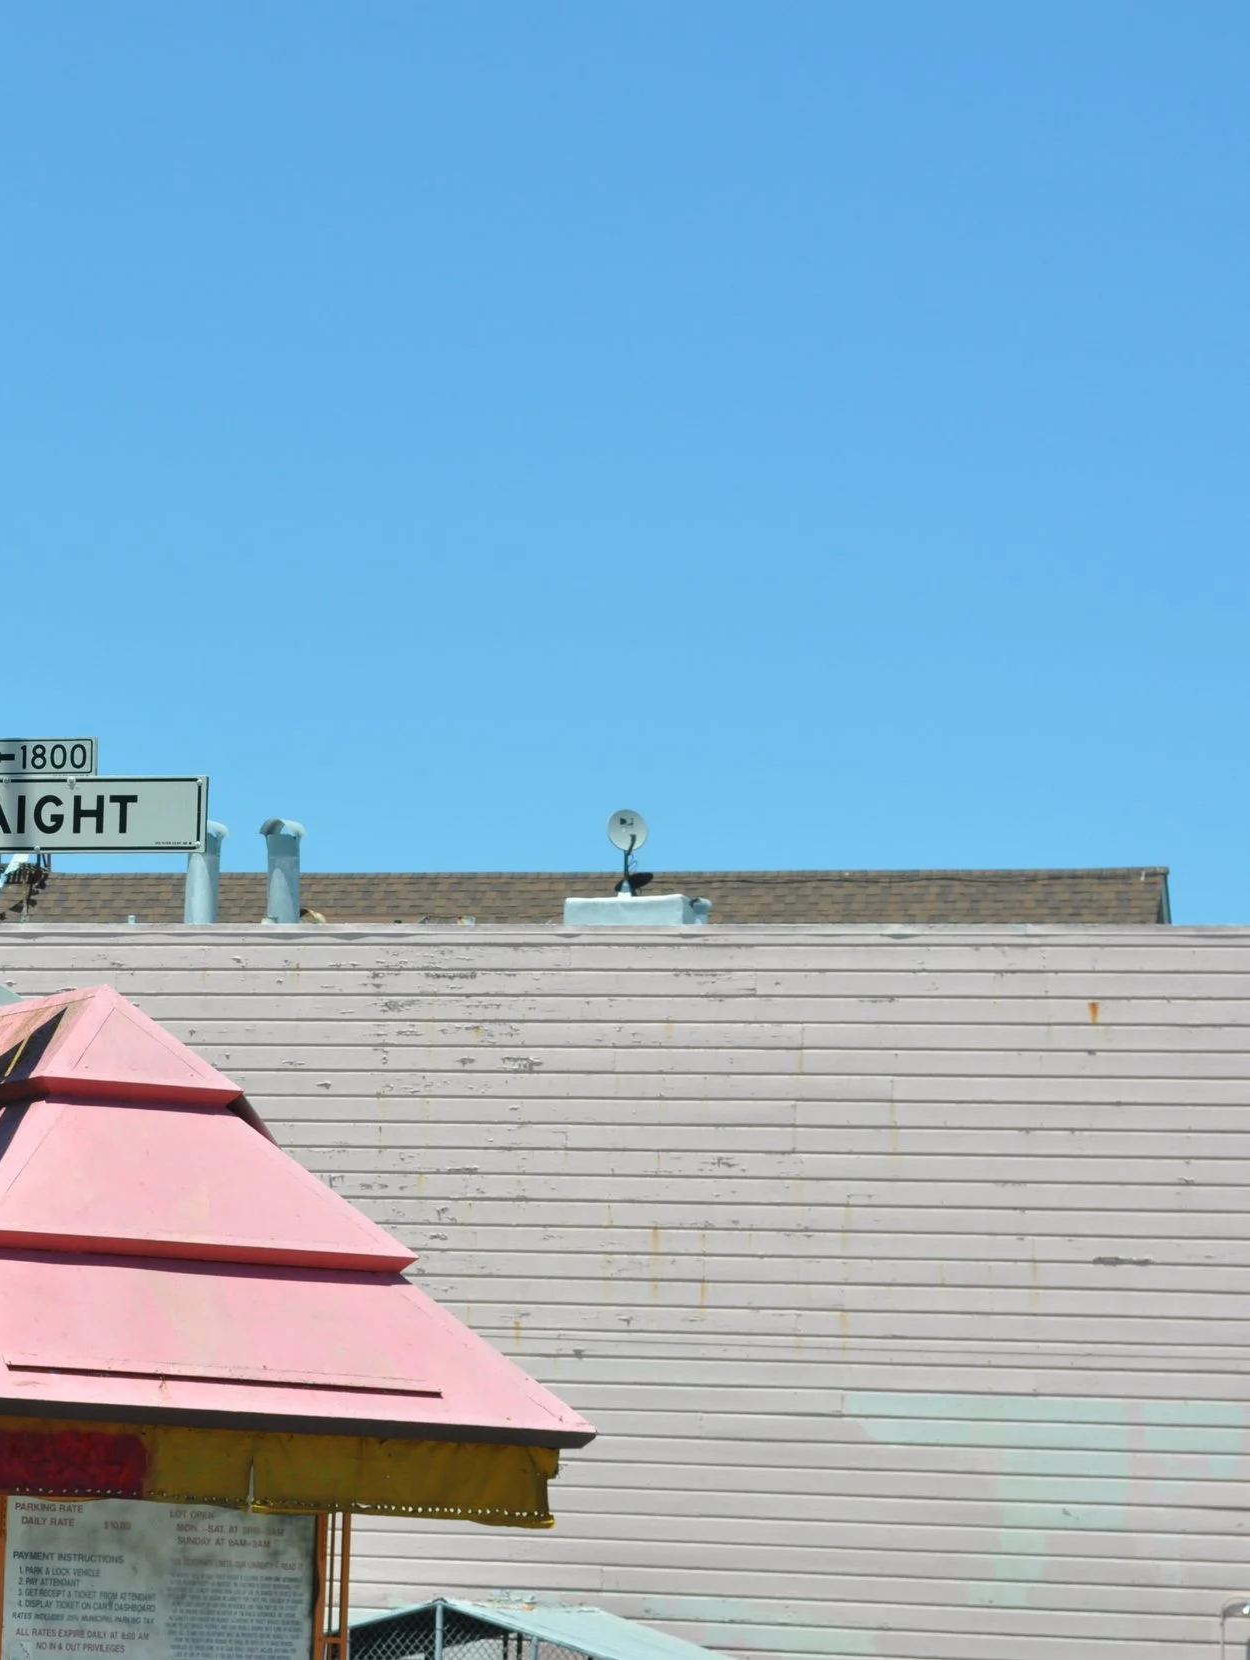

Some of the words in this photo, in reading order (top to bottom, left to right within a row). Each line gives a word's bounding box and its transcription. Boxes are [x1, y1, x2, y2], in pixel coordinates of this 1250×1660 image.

[20, 744, 87, 770] 1800
[15, 1502, 56, 1513] PARKING
[59, 1503, 83, 1514] RATE
[170, 1510, 187, 1518] LOT
[21, 1516, 47, 1526] DAILY
[50, 1518, 75, 1527] RATE
[177, 1536, 211, 1546] SUNDAY
[215, 1537, 225, 1546] AT
[13, 1551, 54, 1561] PAYMENT
[57, 1552, 125, 1564] INSTRUCTIONS
[25, 1567, 42, 1575] PARK
[52, 1568, 70, 1576] LOCK
[73, 1568, 101, 1577] VEHICLE
[26, 1577, 38, 1585] PAY
[40, 1578, 80, 1587] ATTENDANT
[25, 1588, 38, 1597] GET
[74, 1590, 96, 1599] TICKET
[99, 1591, 118, 1600] FROM
[25, 1600, 52, 1609] DISPLAY
[56, 1601, 79, 1610] TICKET
[82, 1602, 91, 1610] ON
[115, 1603, 156, 1613] DASHBOARD
[12, 1612, 32, 1620] RATES
[16, 1627, 29, 1636] ALL
[32, 1628, 56, 1637] RATES
[58, 1629, 84, 1638] EXPIRE
[87, 1630, 106, 1639] DAILY
[110, 1631, 119, 1639] AT
[137, 1632, 150, 1640] AM
[36, 1642, 47, 1650] NO
[49, 1642, 56, 1650] IN
[65, 1643, 81, 1651] OUT
[82, 1643, 126, 1653] PRIVILEGES
